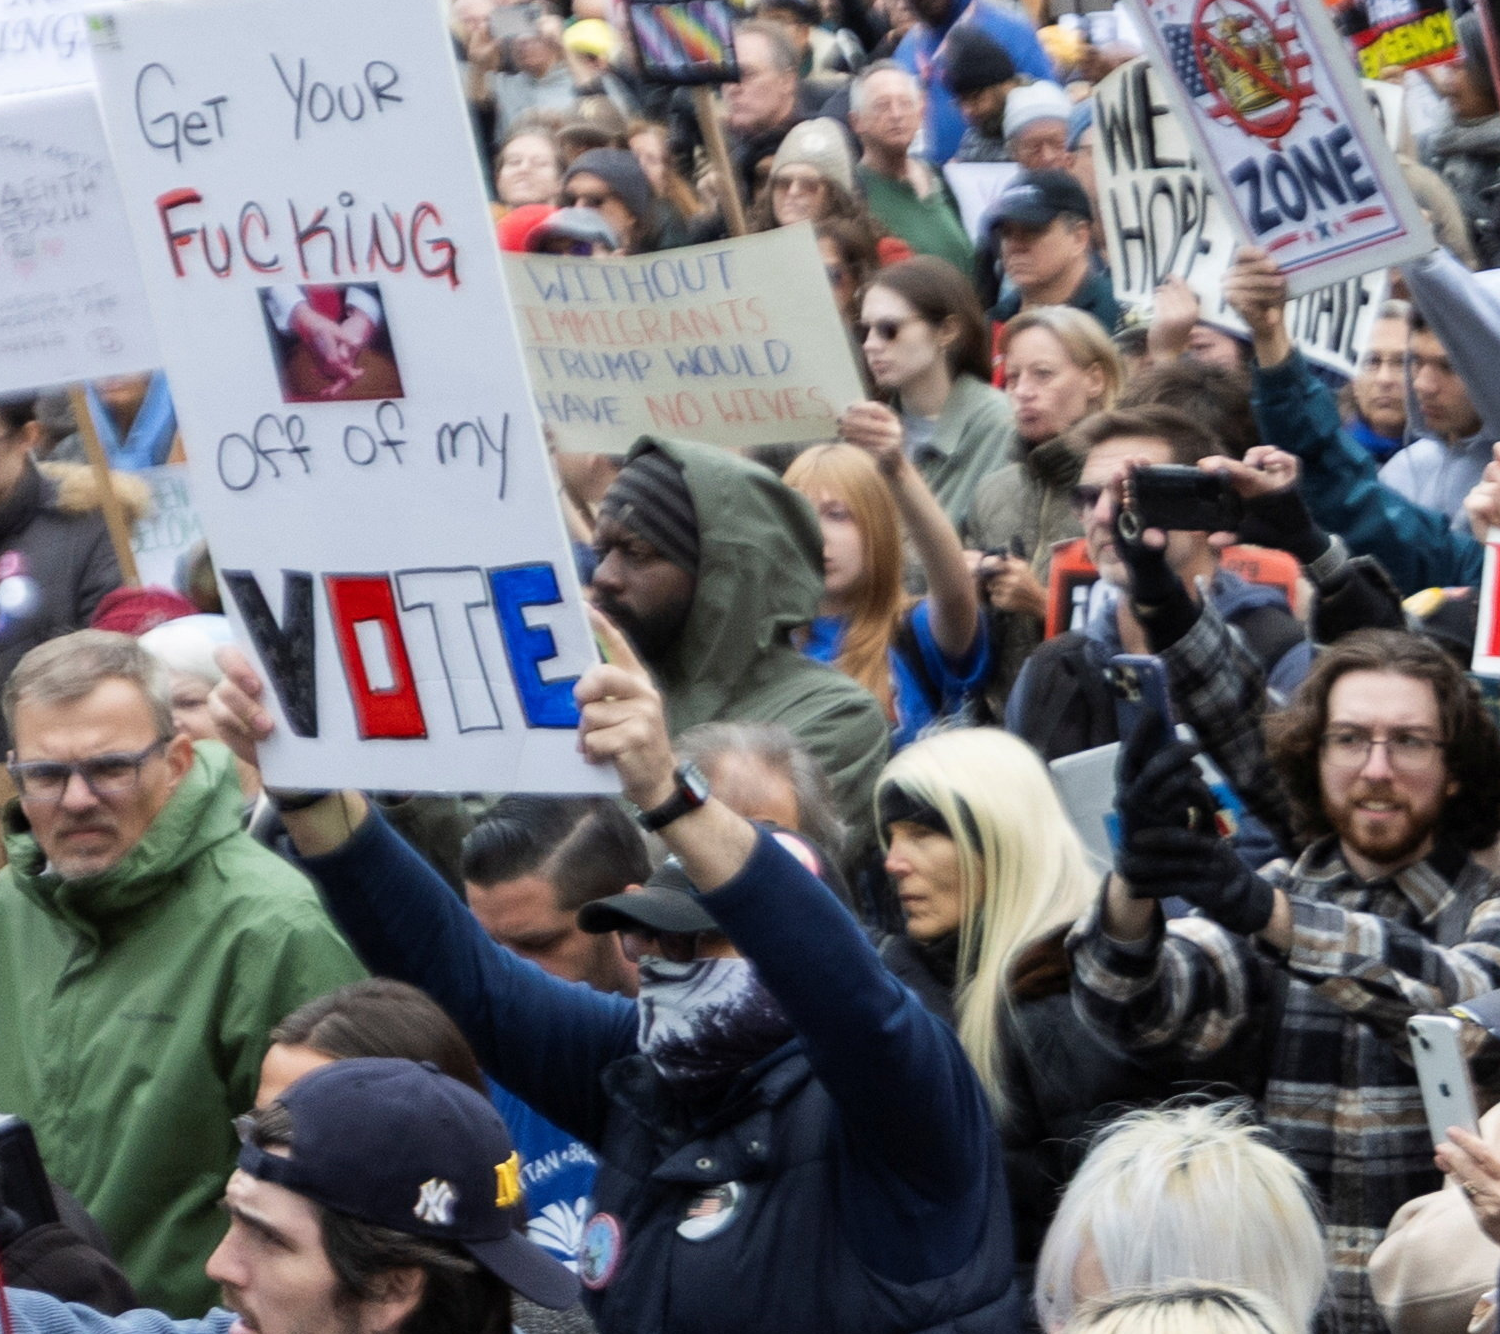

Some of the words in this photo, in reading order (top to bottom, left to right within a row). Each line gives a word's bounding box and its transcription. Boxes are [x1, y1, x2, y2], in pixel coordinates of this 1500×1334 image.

[270, 51, 405, 142] YOUR
[1229, 123, 1379, 237] ZONE
[524, 250, 739, 308] WITHOUT
[521, 295, 771, 356] IMMIGRANTS
[535, 348, 653, 386] TRUMP
[668, 338, 793, 382] WOULD
[535, 389, 624, 430] HAVE
[646, 393, 708, 430] NO
[713, 384, 838, 428] WIVES
[220, 559, 585, 744] VOTE
